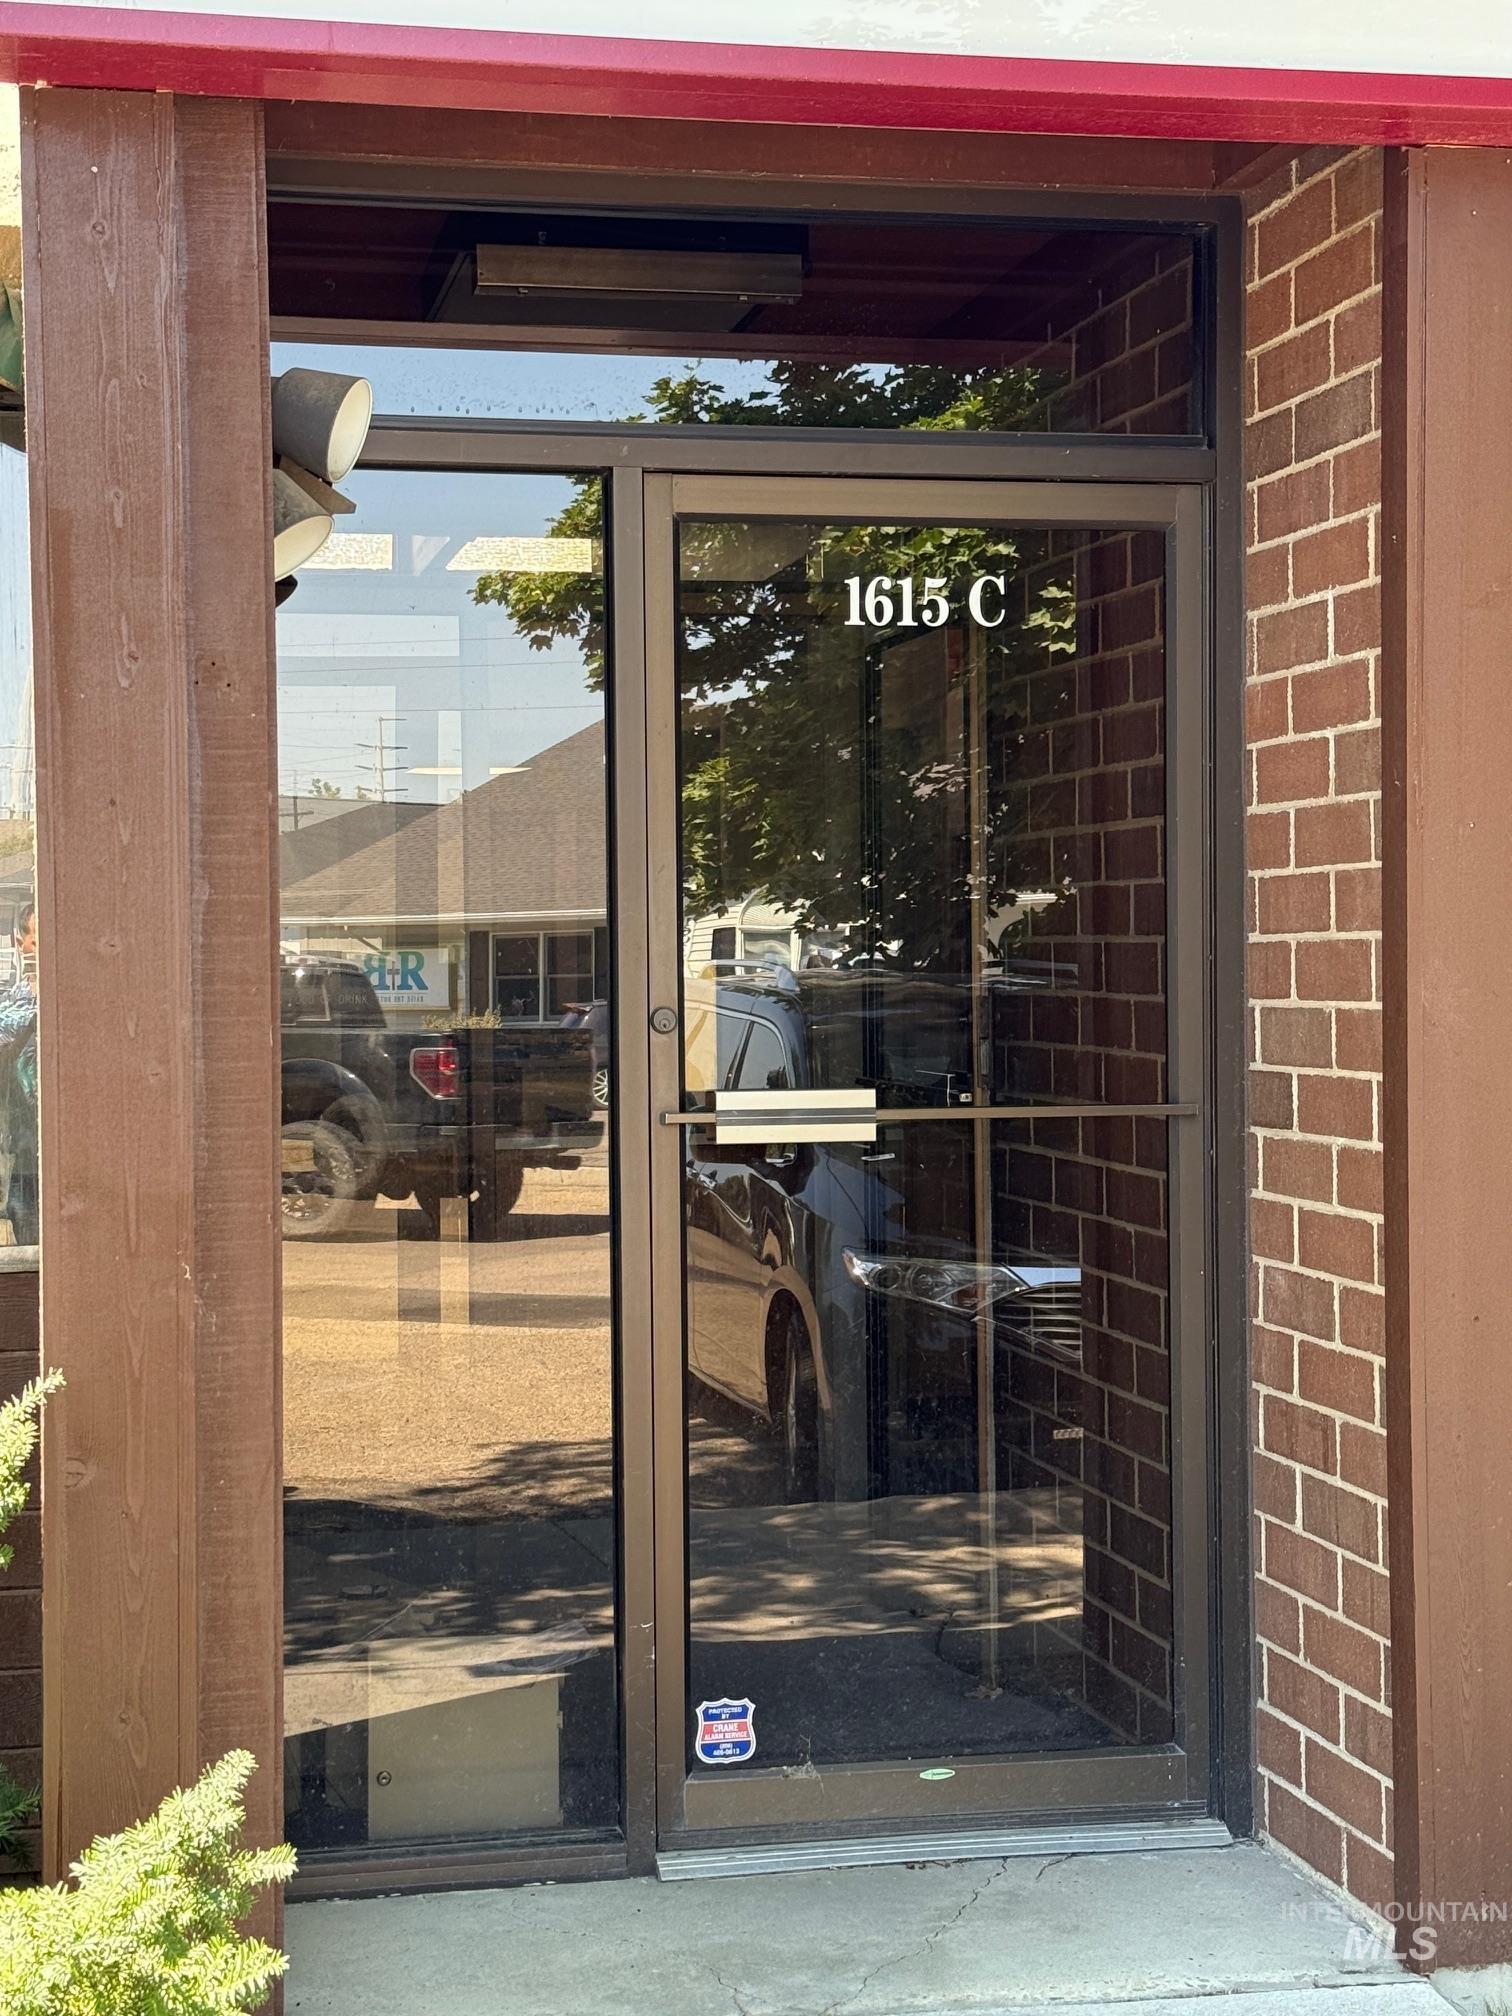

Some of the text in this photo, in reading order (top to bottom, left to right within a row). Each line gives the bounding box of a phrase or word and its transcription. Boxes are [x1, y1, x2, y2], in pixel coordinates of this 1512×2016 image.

[844, 575, 1006, 628] 1615 C
[708, 1706, 743, 1715] PROTECTED
[712, 1722, 739, 1733] CRANE
[704, 1730, 748, 1741] ALARM SERVICE
